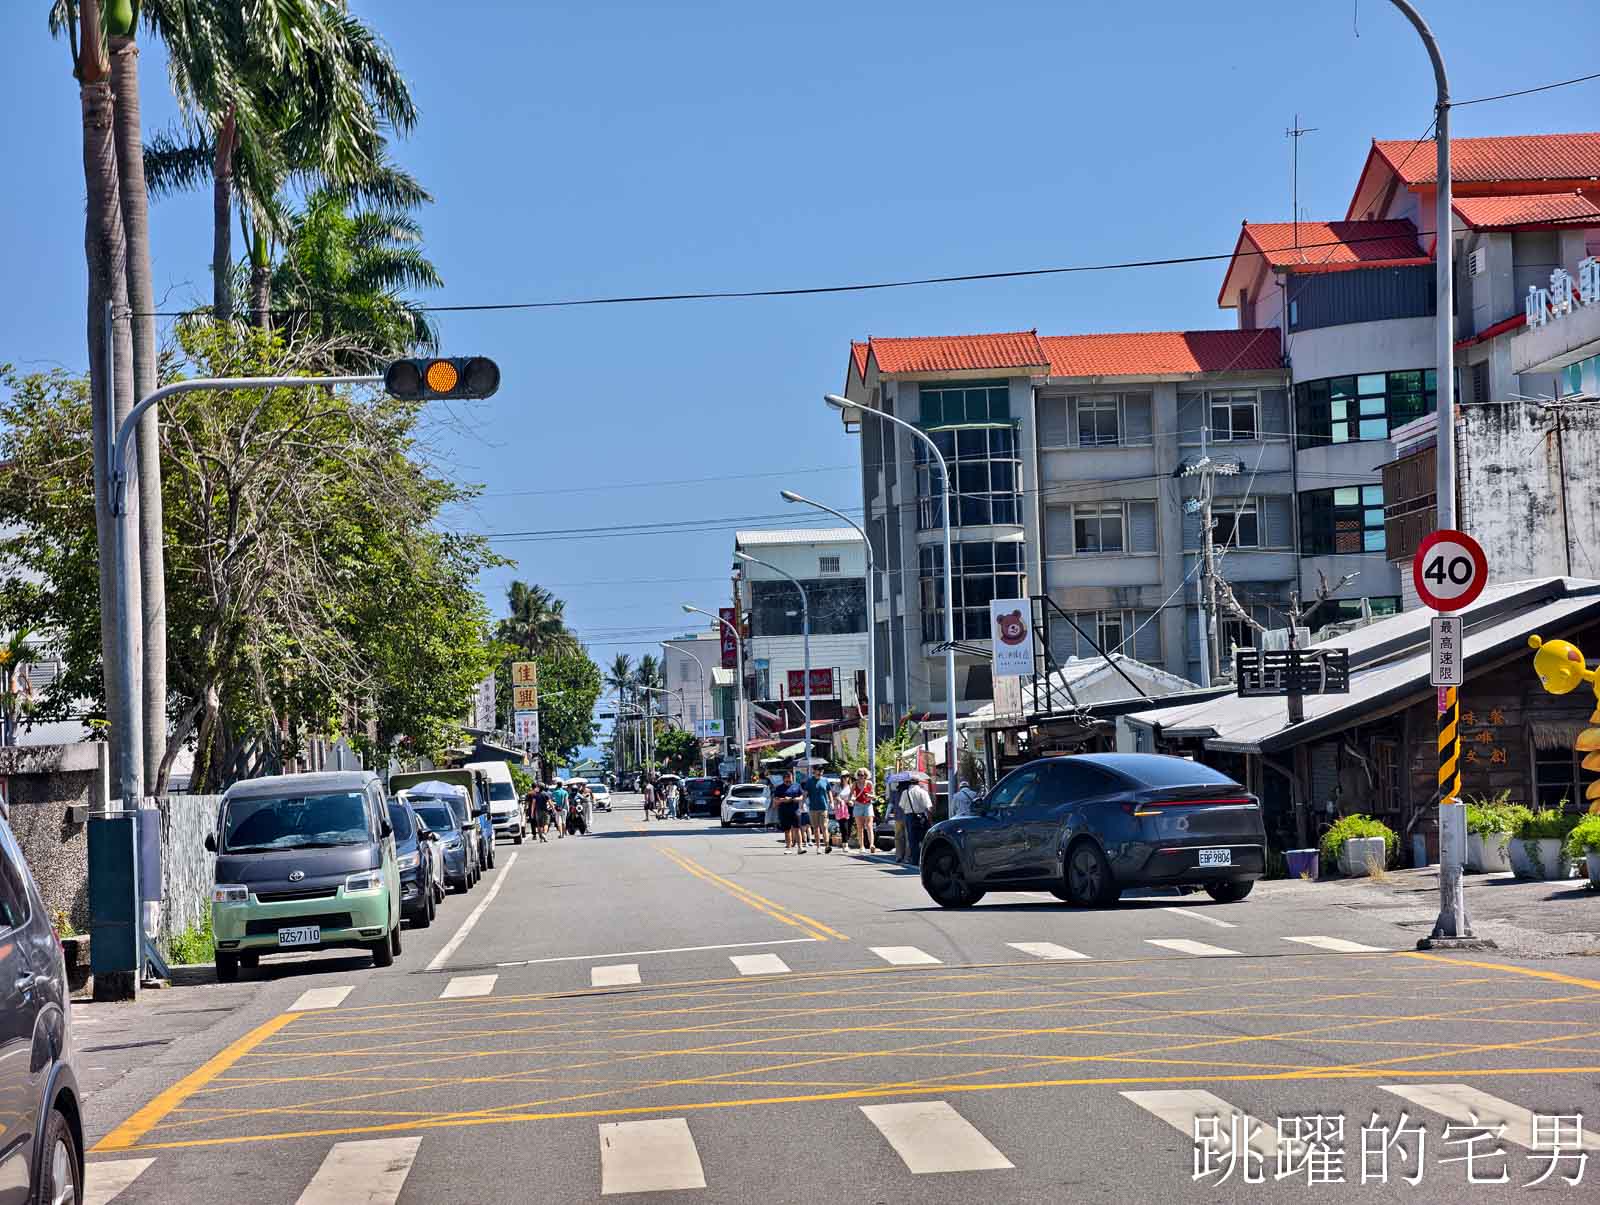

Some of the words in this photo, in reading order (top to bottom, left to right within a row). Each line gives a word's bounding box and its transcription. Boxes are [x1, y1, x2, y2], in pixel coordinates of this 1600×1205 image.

[1424, 556, 1473, 585] 40
[1439, 620, 1454, 680] 最高速限
[516, 664, 535, 707] 佳興
